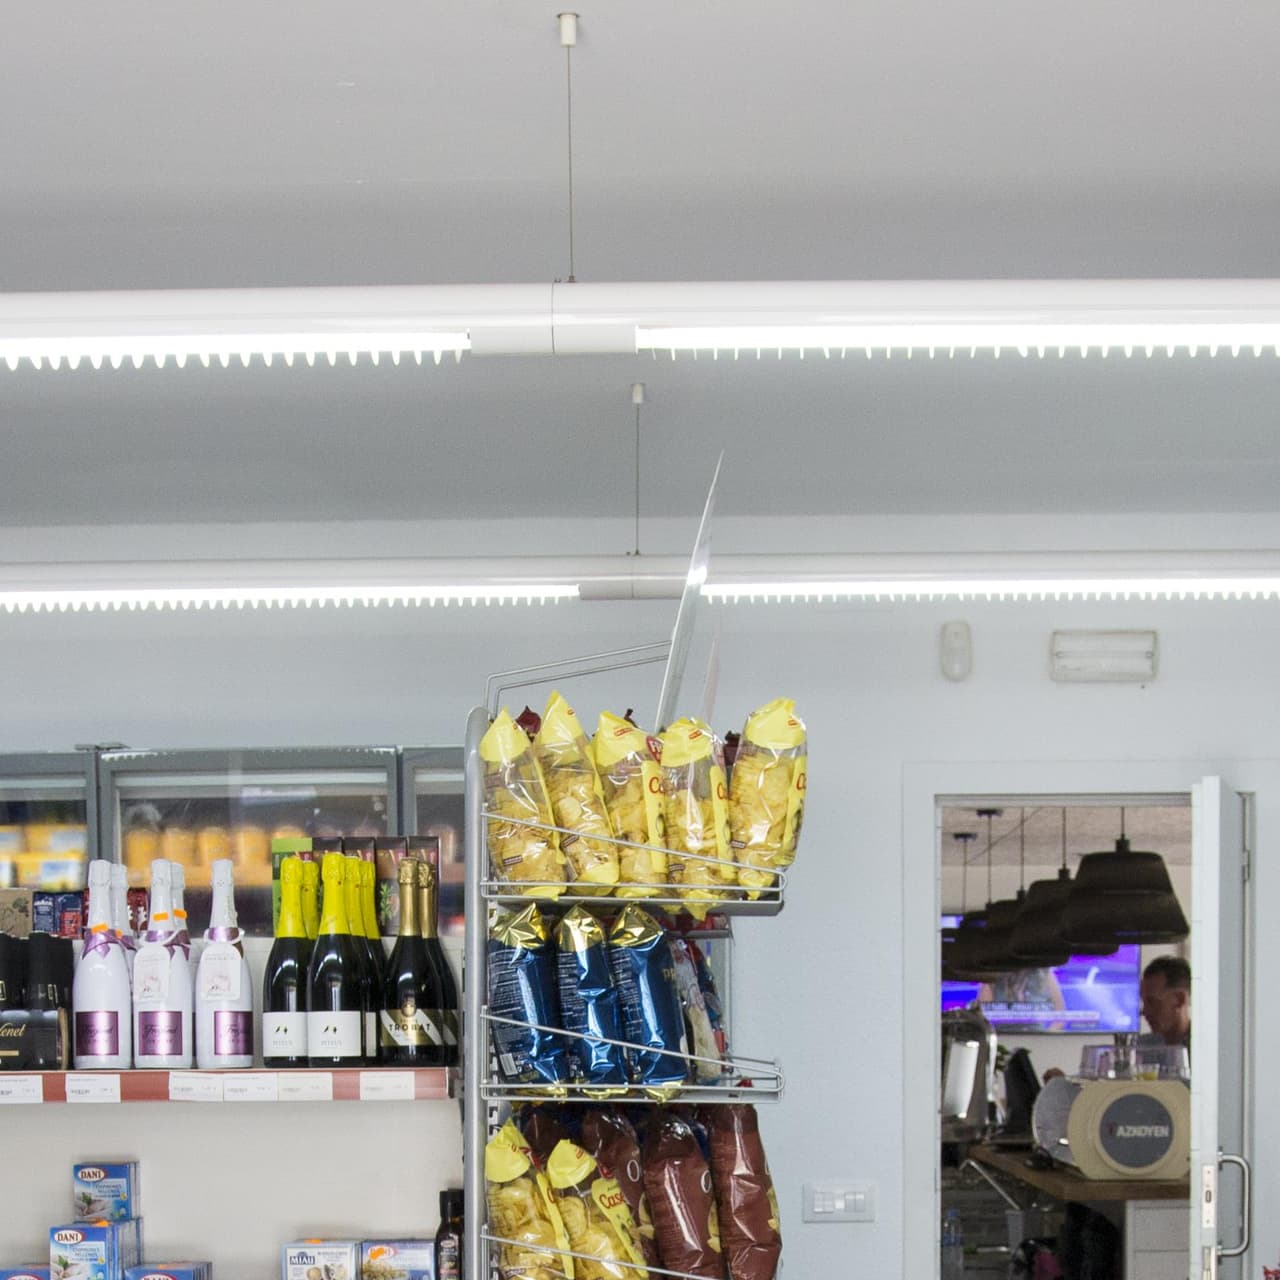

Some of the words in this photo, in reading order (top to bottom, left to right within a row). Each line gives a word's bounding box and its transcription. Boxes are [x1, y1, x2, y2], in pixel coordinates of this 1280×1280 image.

[80, 1170, 102, 1180] DANI
[57, 1233, 79, 1242] DANI
[289, 1255, 316, 1265] MIAU
